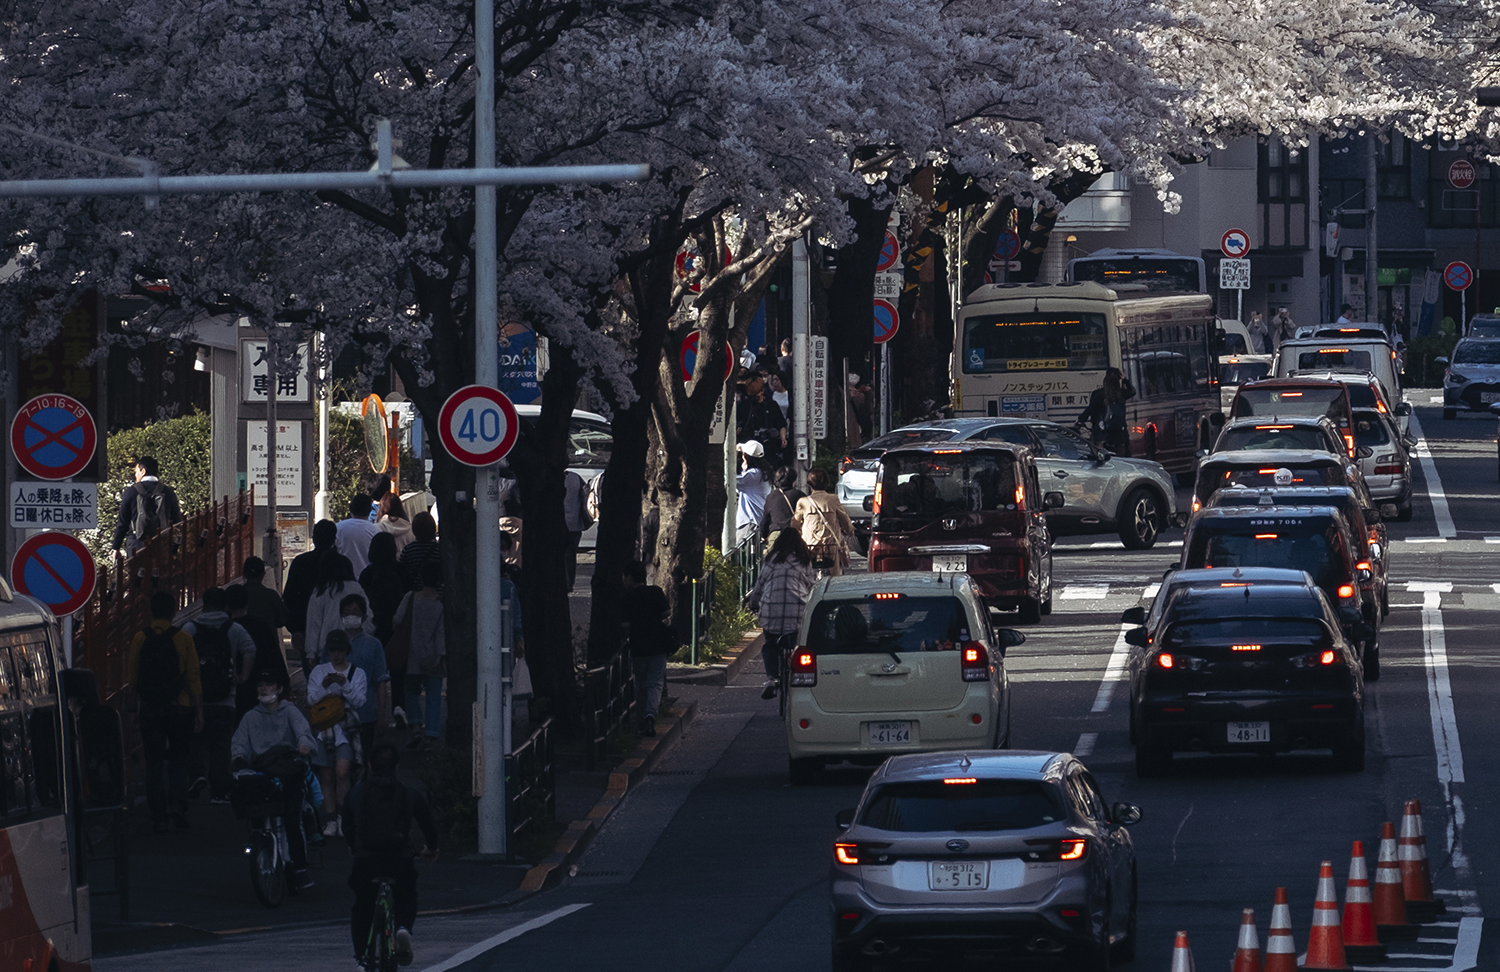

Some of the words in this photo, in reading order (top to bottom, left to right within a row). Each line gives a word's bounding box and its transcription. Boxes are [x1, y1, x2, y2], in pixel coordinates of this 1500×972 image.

[1002, 382, 1070, 392] ノンステップバス
[458, 408, 500, 443] 40
[15, 488, 92, 504] 人の乗降を除く
[14, 507, 92, 523] 日曜・休日を除く
[878, 730, 910, 742] 61-64
[1237, 729, 1267, 741] 48-11
[960, 864, 974, 872] 312
